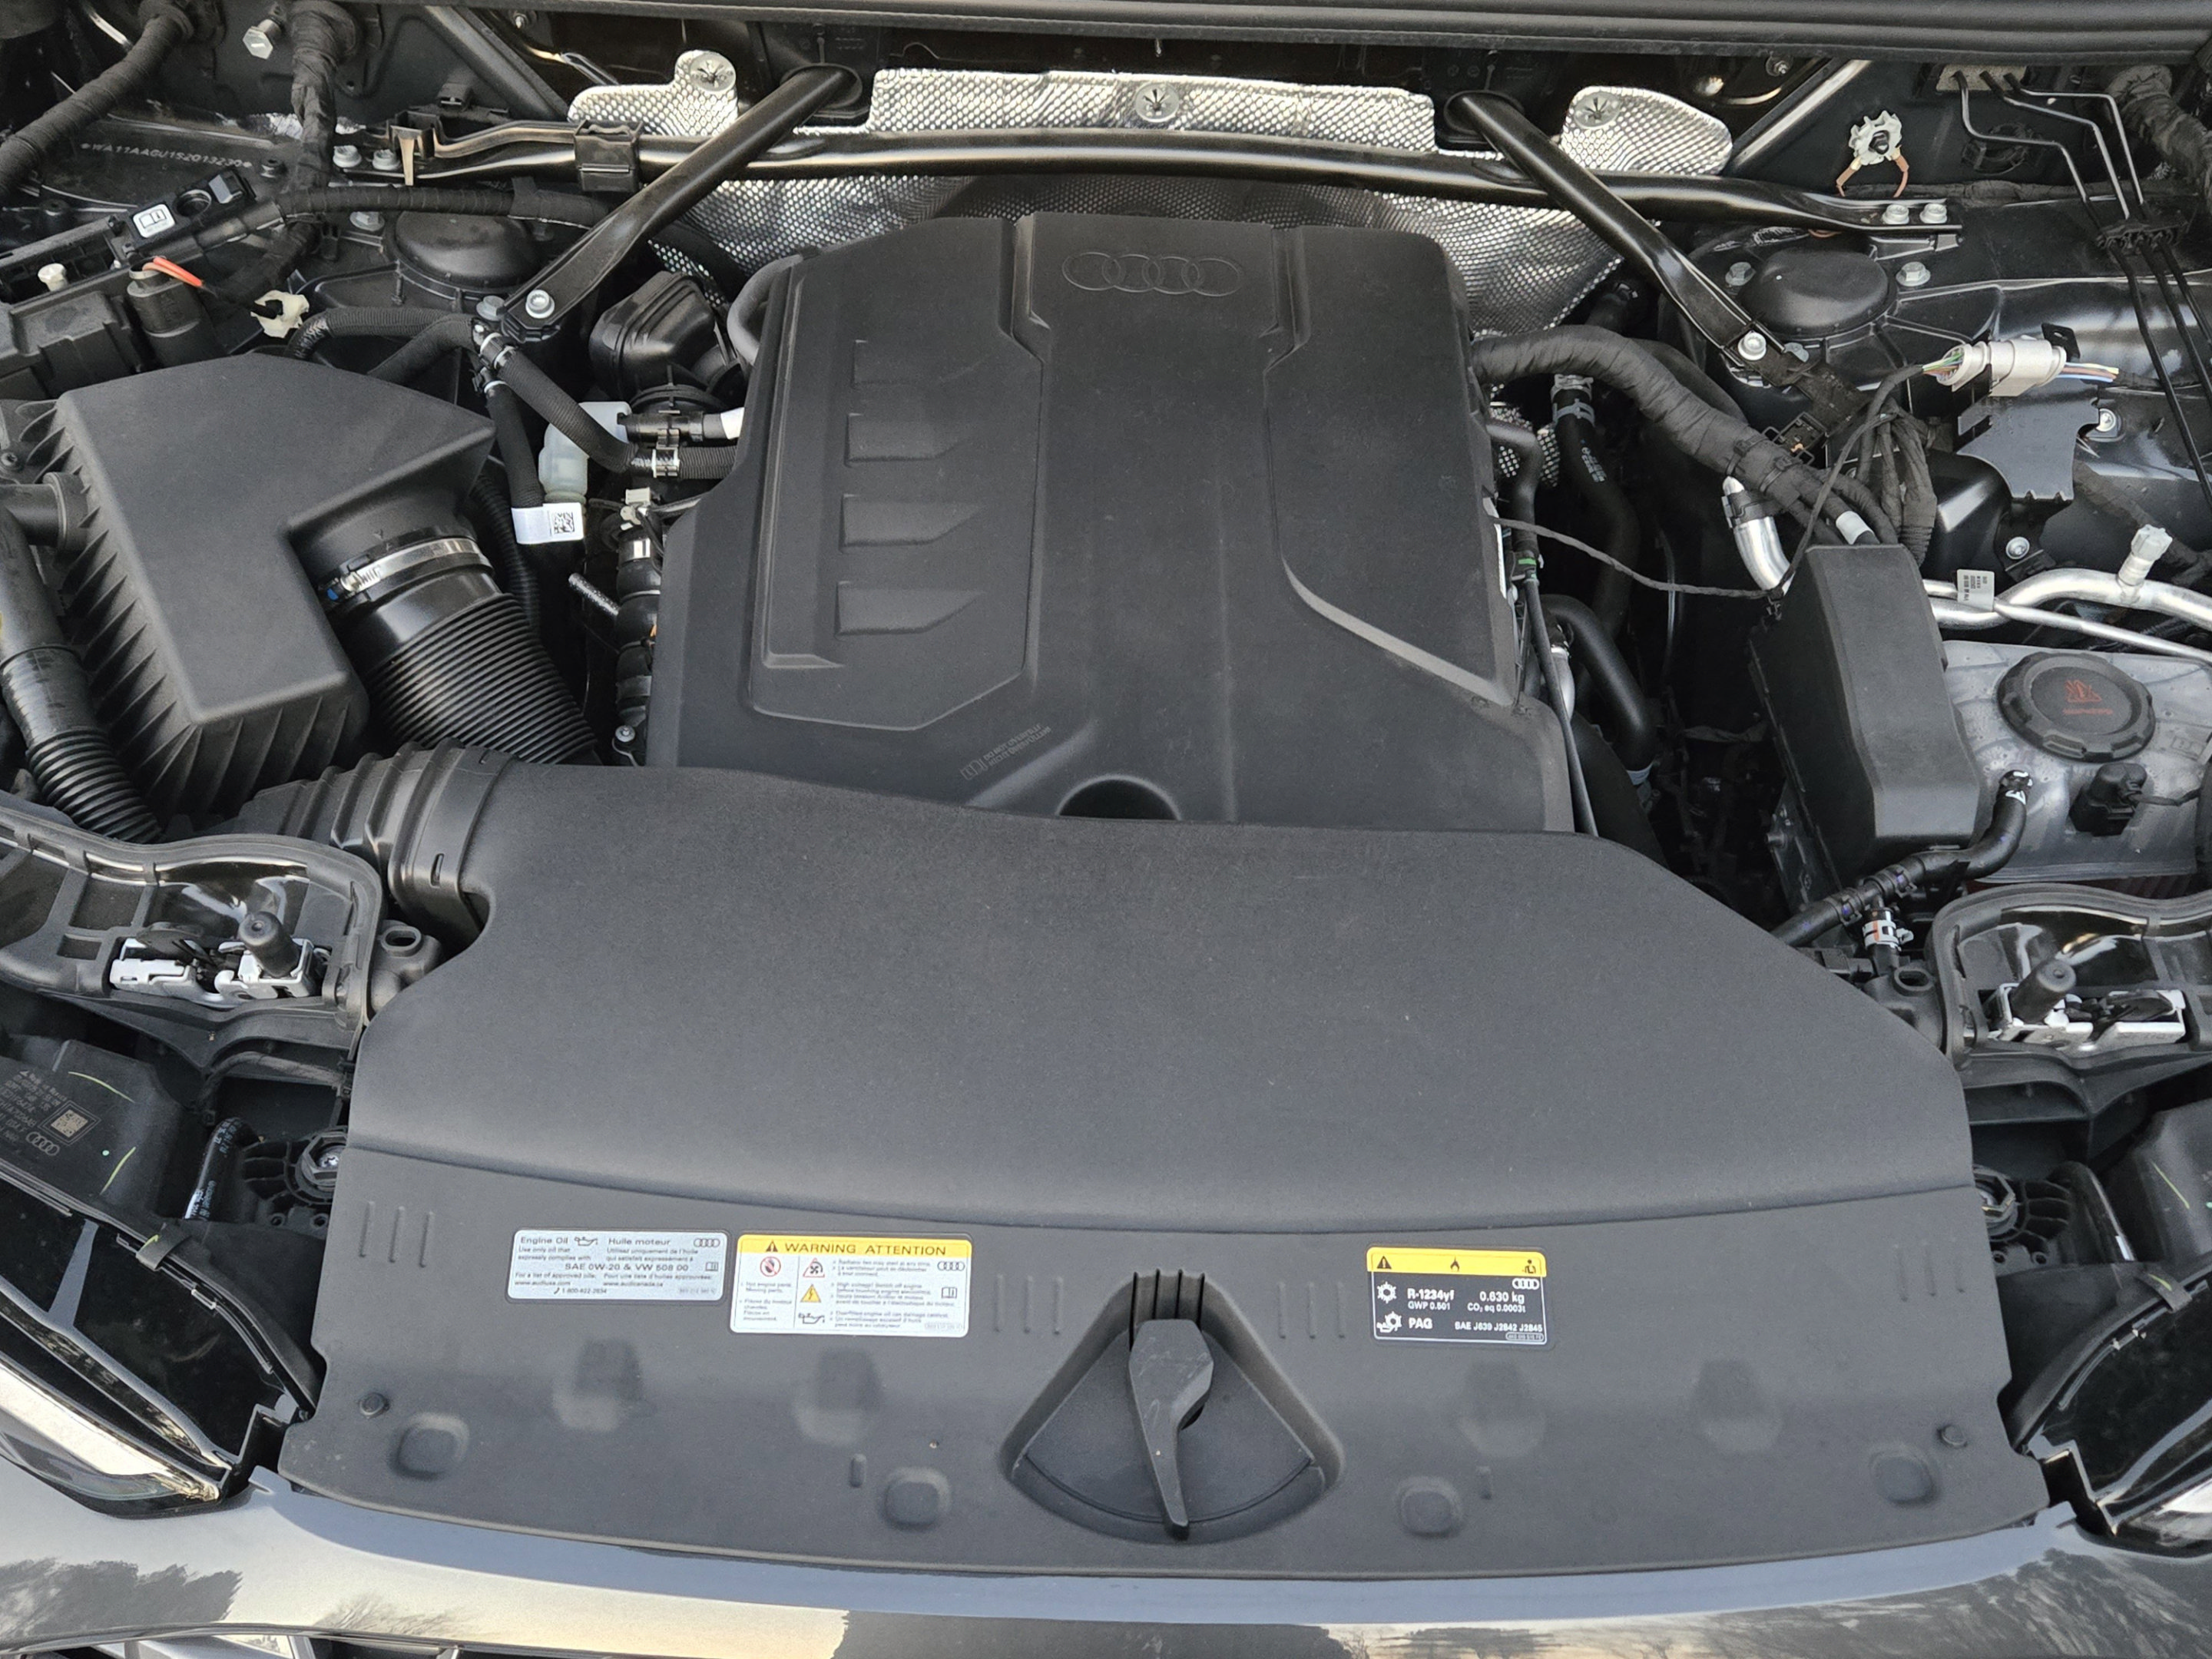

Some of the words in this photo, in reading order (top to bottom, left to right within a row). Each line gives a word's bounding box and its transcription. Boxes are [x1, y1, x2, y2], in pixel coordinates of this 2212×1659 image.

[520, 1237, 552, 1245] Engine
[784, 1243, 856, 1253] WARNING
[865, 1245, 946, 1256] ATTENTION
[1406, 1287, 1455, 1302] R-1234yf
[1479, 1290, 1509, 1302] 0.630
[1511, 1290, 1525, 1304] kg
[1408, 1301, 1428, 1310] GWP
[1409, 1317, 1433, 1330] PAG
[1455, 1321, 1472, 1330] SAE
